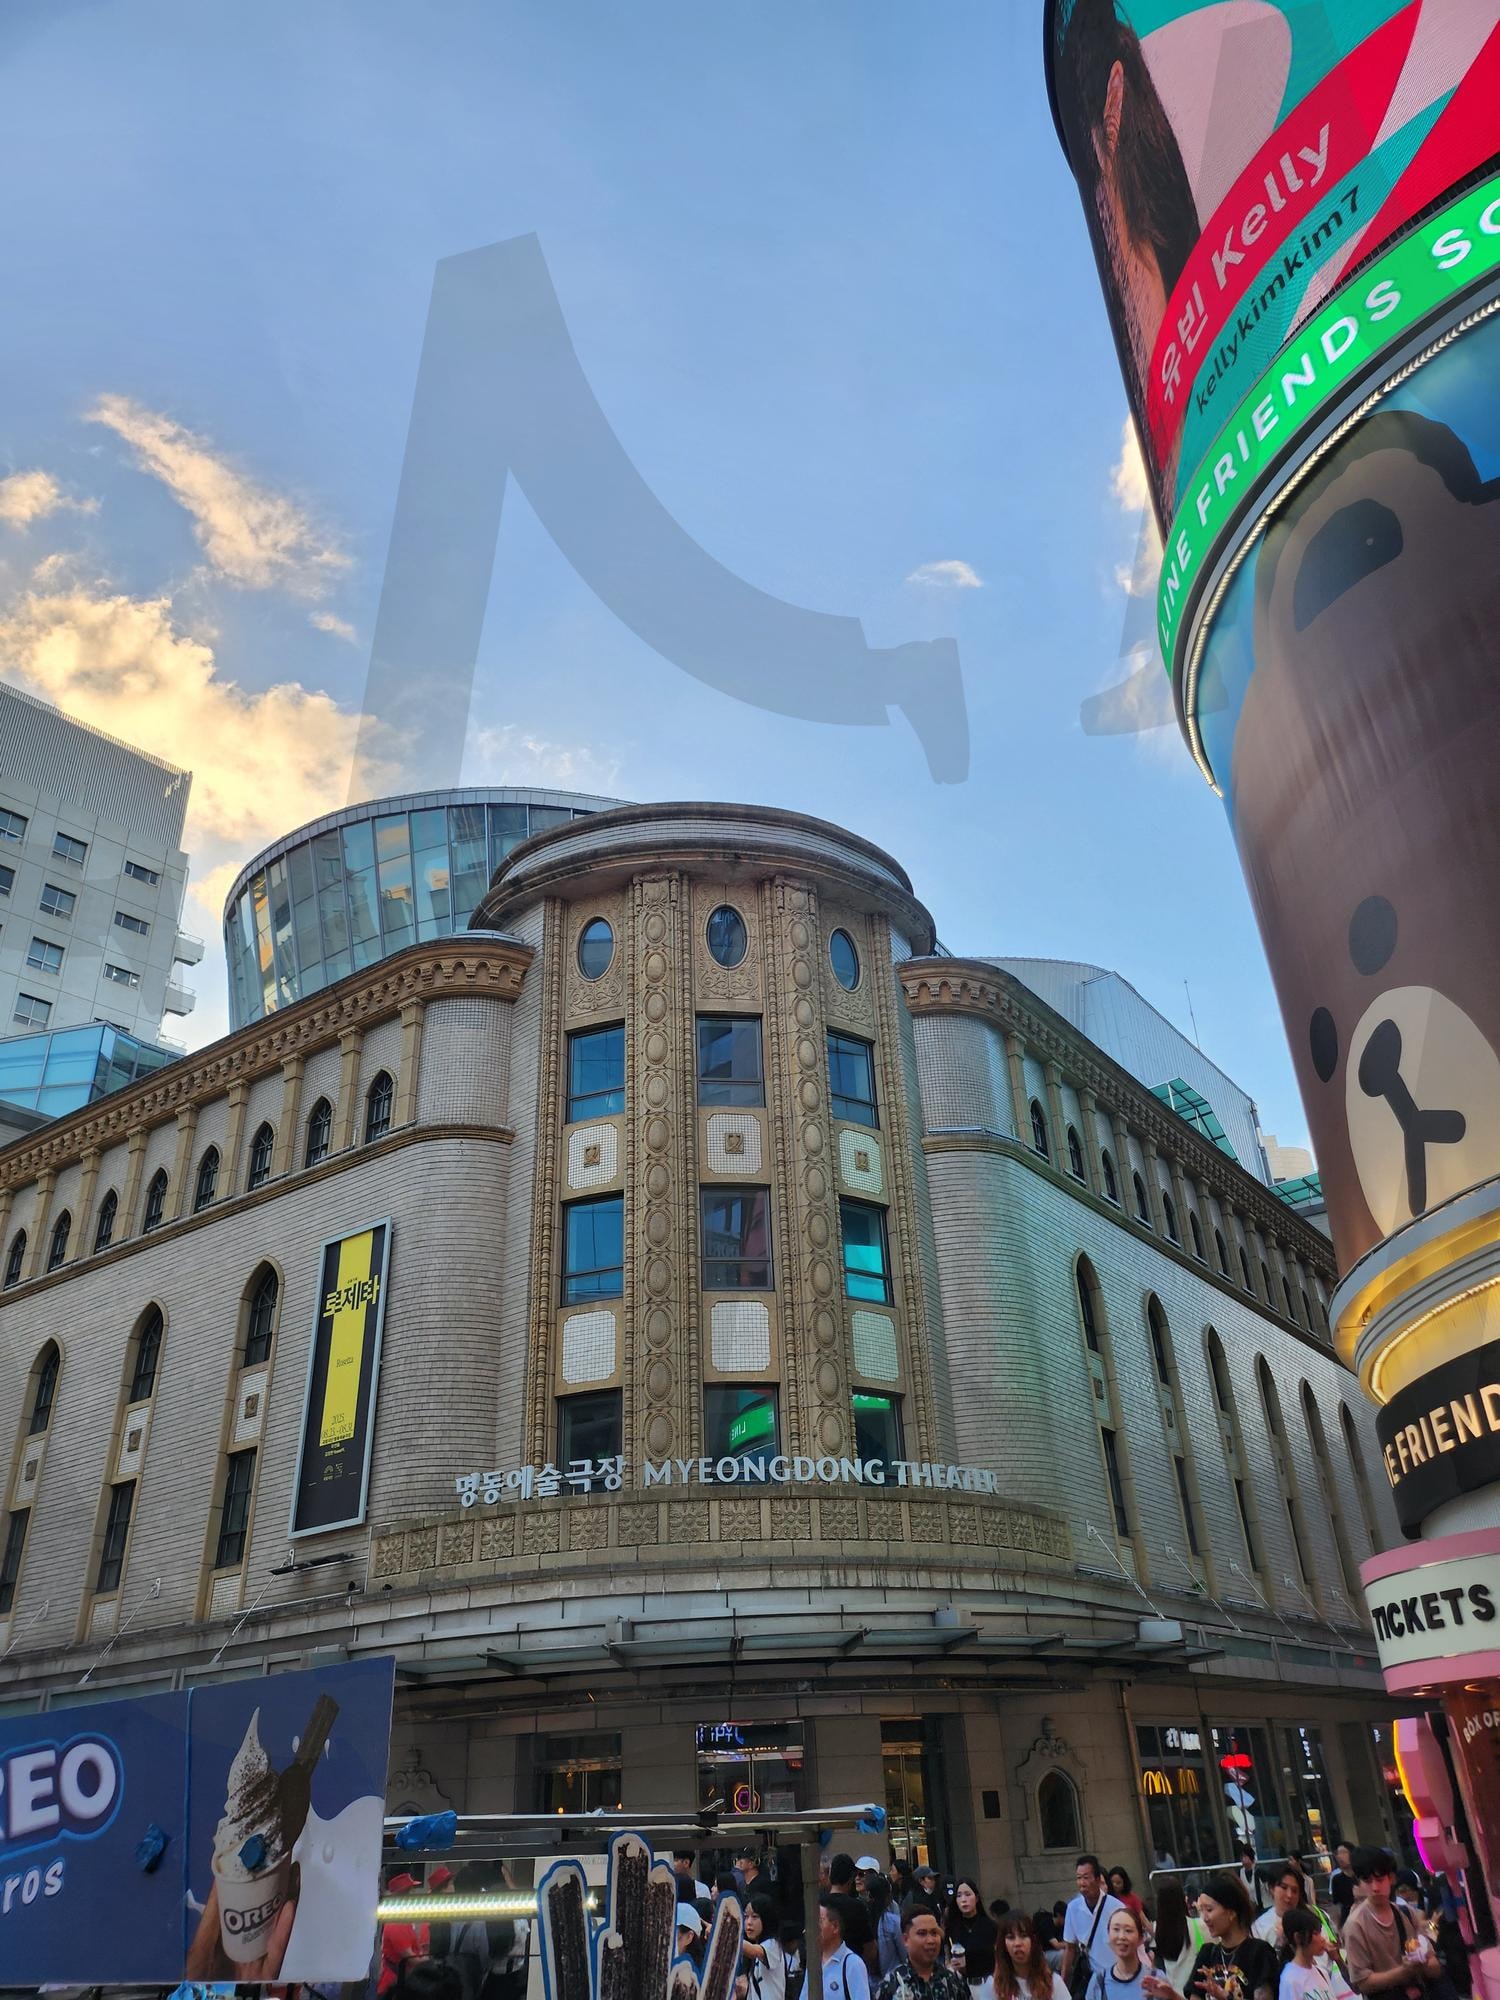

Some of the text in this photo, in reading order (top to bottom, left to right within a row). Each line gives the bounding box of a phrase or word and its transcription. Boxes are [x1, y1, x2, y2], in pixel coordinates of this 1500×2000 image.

[1161, 121, 1329, 404] 유빈 Kelly
[1196, 184, 1360, 415] kellykimkim7
[1161, 529, 1192, 649] LINE
[1196, 279, 1402, 527] FRIENDS
[323, 1274, 380, 1318] 로제타
[456, 1455, 1000, 1508] 명동예술극장 MYEONGDONG THEATER
[1371, 1584, 1496, 1642] TICKETS
[0, 1743, 116, 1839] EO
[224, 1893, 282, 1935] OREO
